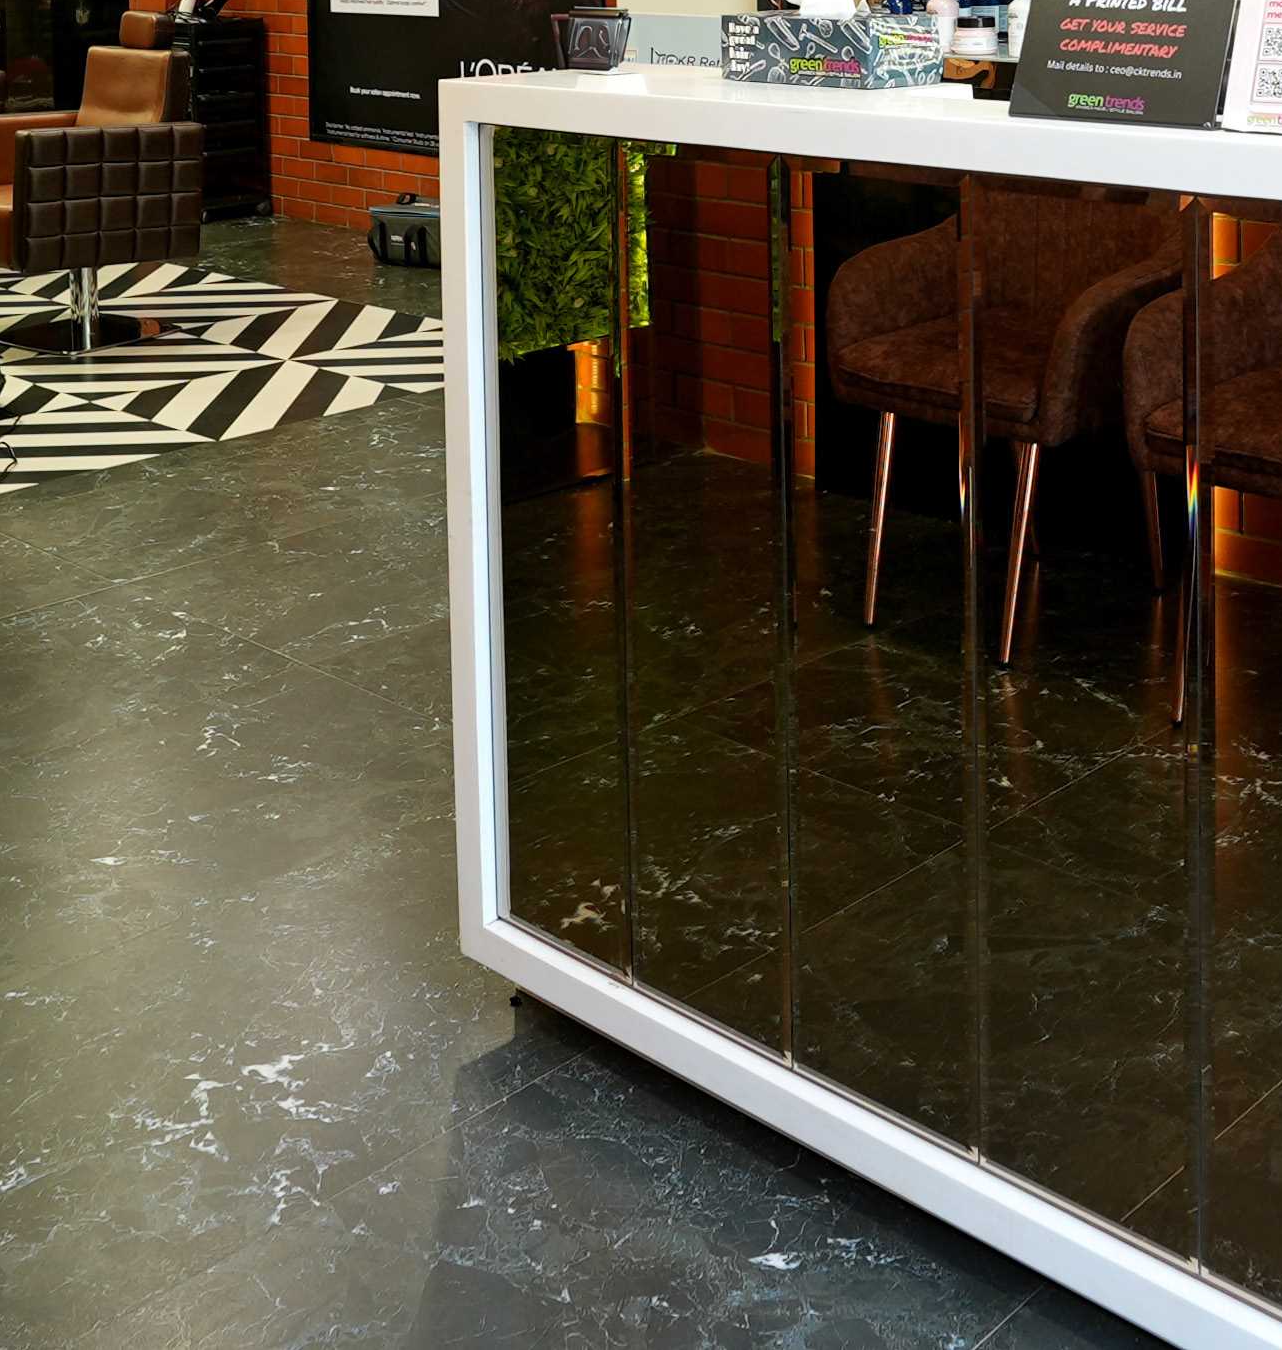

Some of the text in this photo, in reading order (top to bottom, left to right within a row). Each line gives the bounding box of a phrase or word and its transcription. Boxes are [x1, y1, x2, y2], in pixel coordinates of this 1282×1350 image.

[1060, 18, 1187, 37] GET YOUR SERVICE
[1059, 38, 1179, 58] COMPLIMENTARY
[790, 58, 823, 74] green
[1047, 60, 1064, 70] Mail
[1065, 61, 1093, 73] details
[1095, 64, 1104, 74] to
[1110, 66, 1182, 80] ceo@cktrends.in
[1068, 94, 1145, 110] green trends
